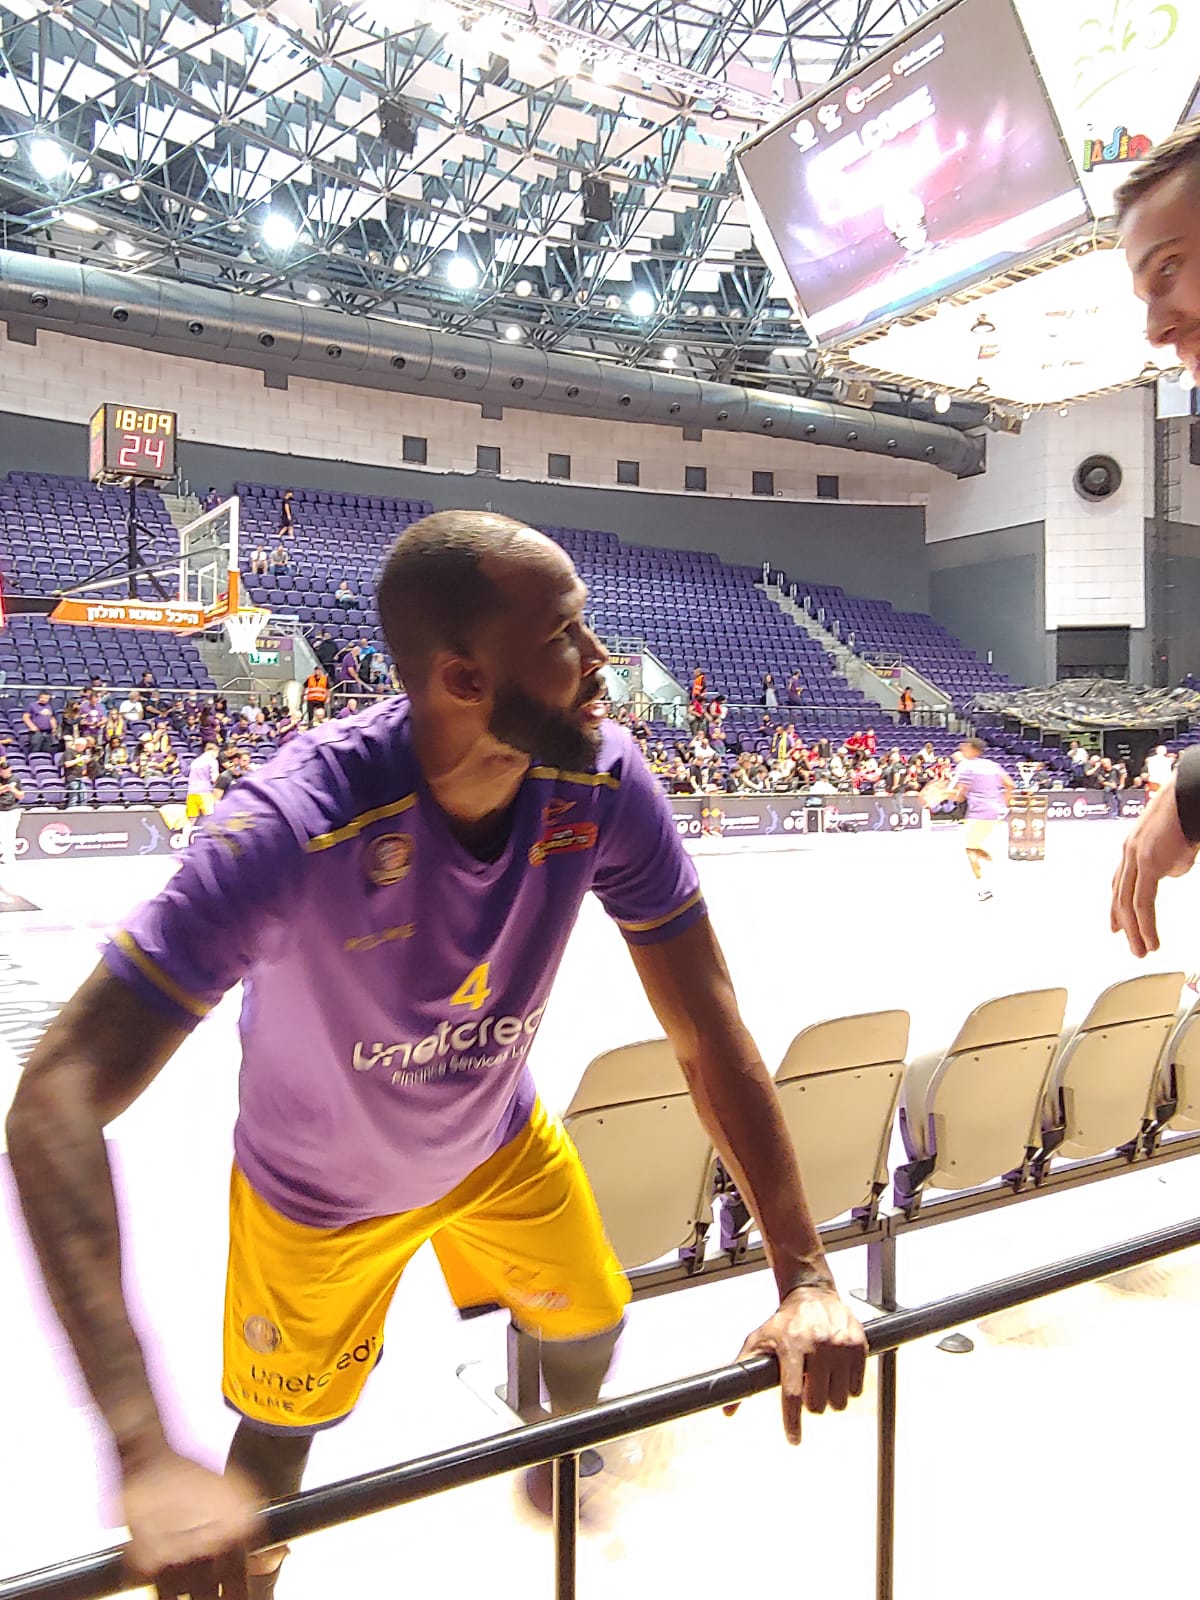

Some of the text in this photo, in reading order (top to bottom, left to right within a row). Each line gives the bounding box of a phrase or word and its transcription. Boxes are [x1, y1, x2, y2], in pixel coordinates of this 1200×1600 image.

[115, 409, 172, 435] 18:09
[119, 434, 164, 468] 24
[87, 605, 199, 624] היכל טוטו חולון
[449, 961, 491, 1010] 4
